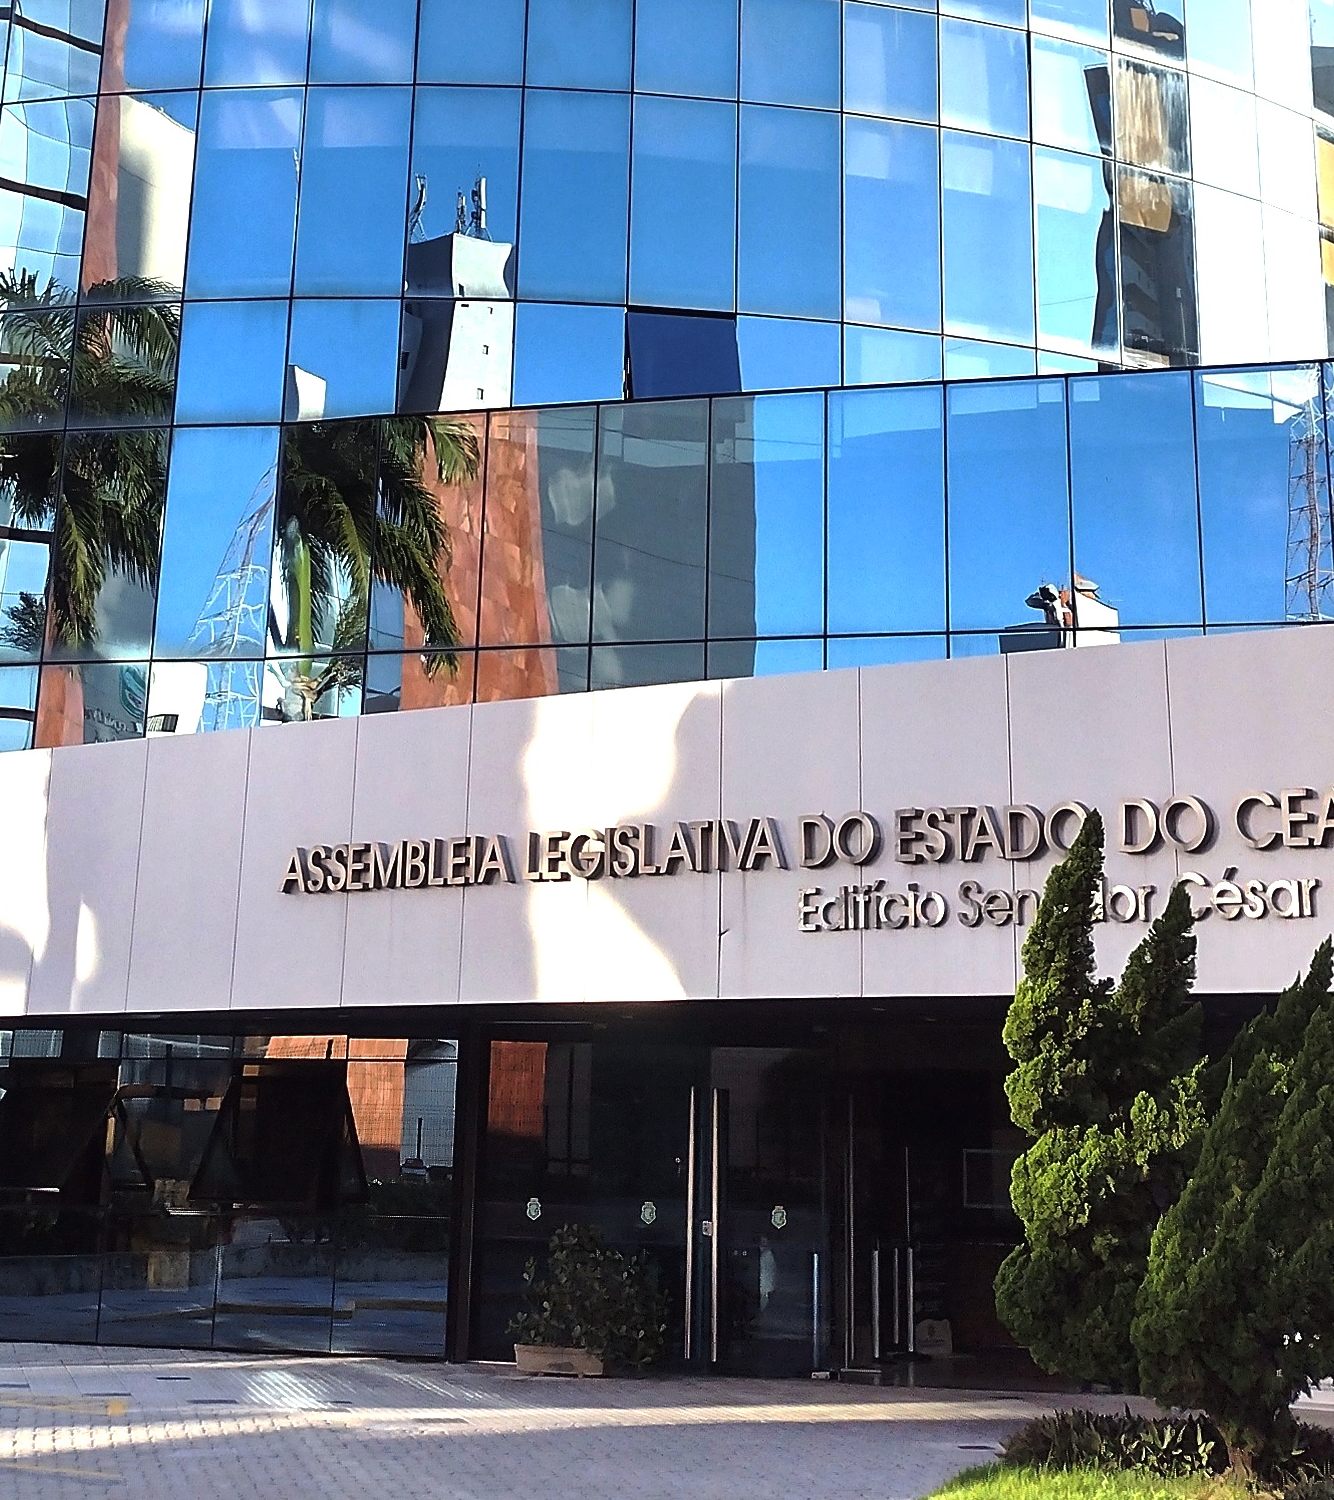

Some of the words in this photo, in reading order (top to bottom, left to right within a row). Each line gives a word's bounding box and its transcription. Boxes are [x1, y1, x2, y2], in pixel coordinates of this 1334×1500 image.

[278, 834, 516, 894] ASSEMBLEIA
[523, 817, 789, 882] LEGISLATIVA
[798, 811, 882, 869] DO
[894, 800, 1093, 863] ESTADO
[1119, 795, 1217, 853] DO
[798, 879, 948, 931] Edifício
[957, 876, 1157, 927] Sendor
[1169, 867, 1322, 921] César
